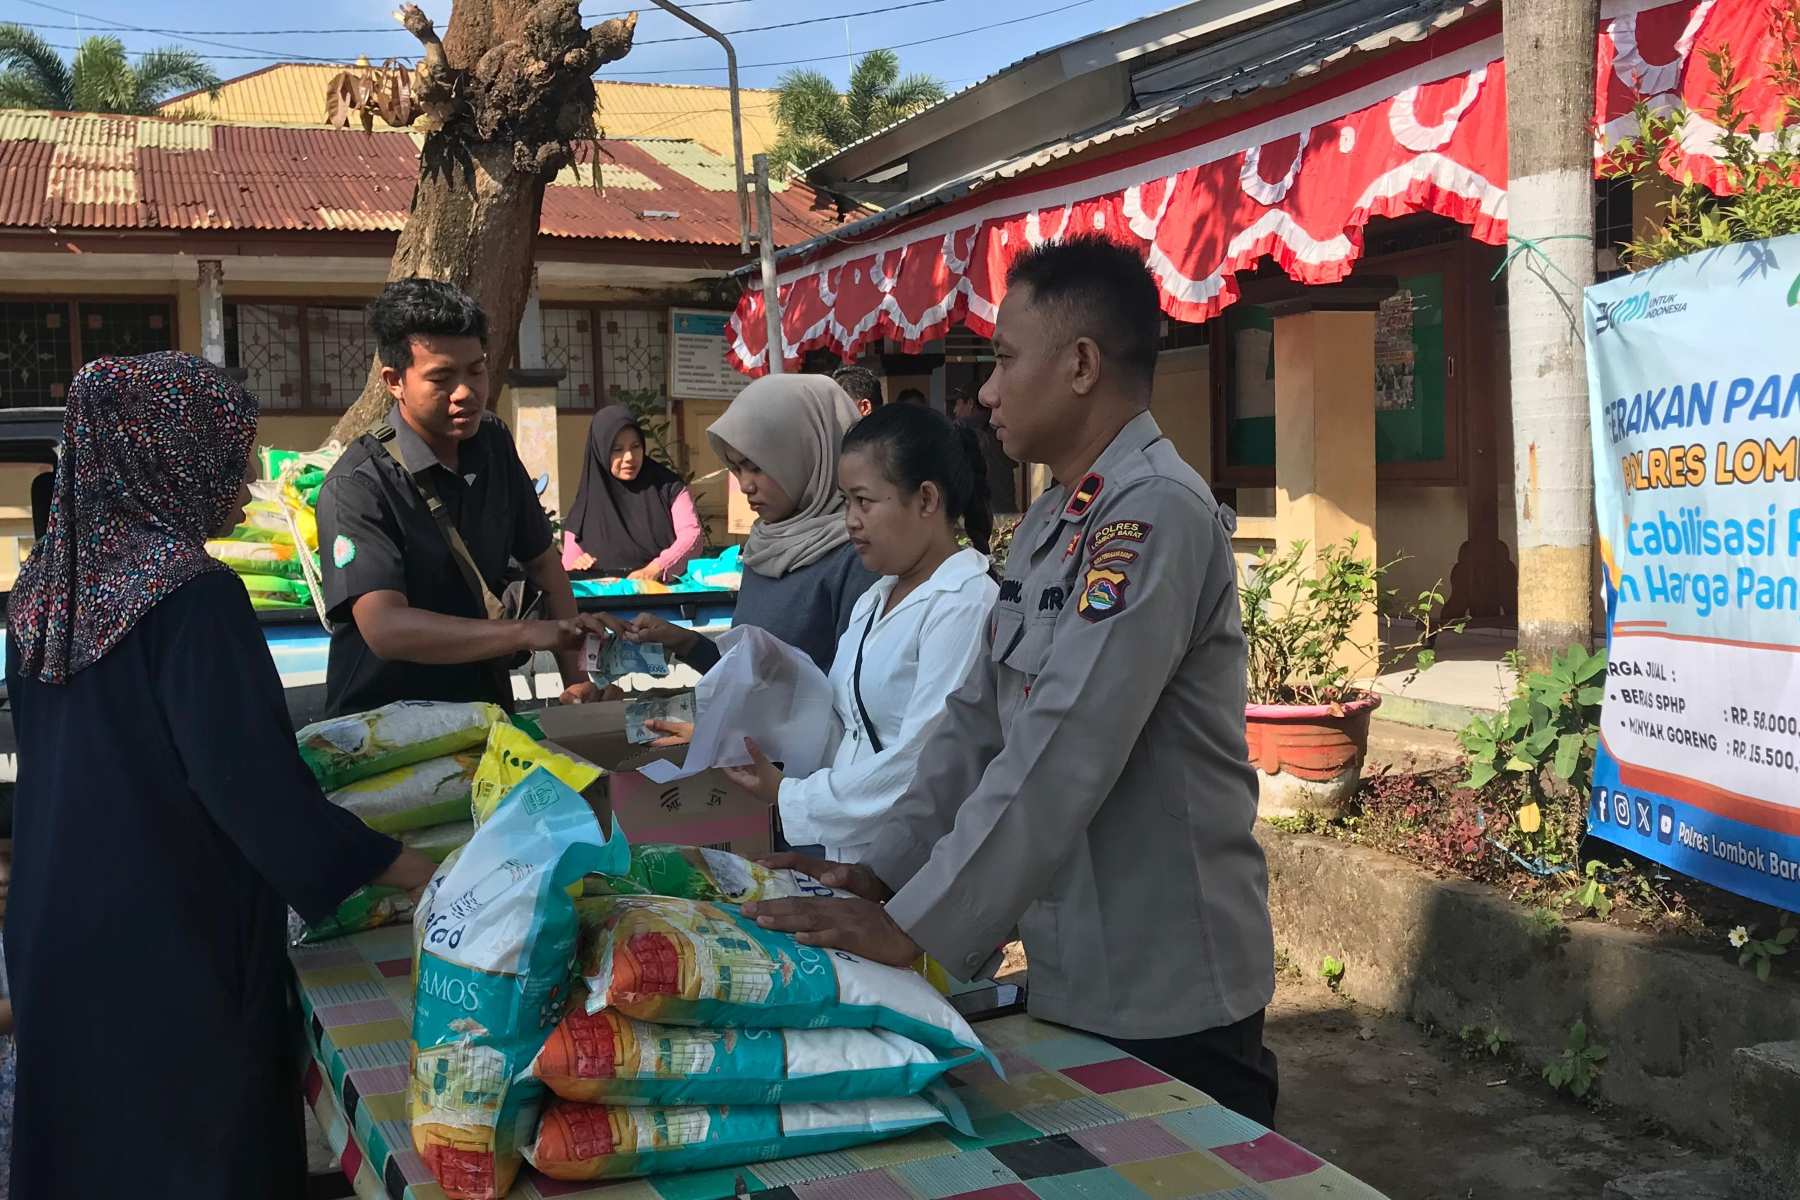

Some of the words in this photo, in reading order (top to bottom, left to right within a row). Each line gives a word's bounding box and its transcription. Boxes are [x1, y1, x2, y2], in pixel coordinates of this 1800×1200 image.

[1645, 302, 1687, 319] INDONESIA
[1650, 293, 1678, 308] UNTUK
[1605, 379, 1718, 446] ERAKAN
[1715, 436, 1800, 485] LOM
[1095, 522, 1140, 541] POLRES
[1117, 530, 1144, 540] BARAT
[1644, 564, 1730, 618] Harga
[1606, 661, 1643, 677] RGA
[1646, 661, 1667, 681] JUAL
[1621, 688, 1653, 709] BERAS
[1656, 694, 1686, 714] SPHP
[1731, 706, 1750, 727] RP.
[1628, 716, 1665, 741] MINYAK
[1666, 726, 1718, 752] GORENG
[1733, 739, 1747, 760] RP.
[1678, 821, 1709, 853] Polres
[1711, 834, 1765, 872] Lombok
